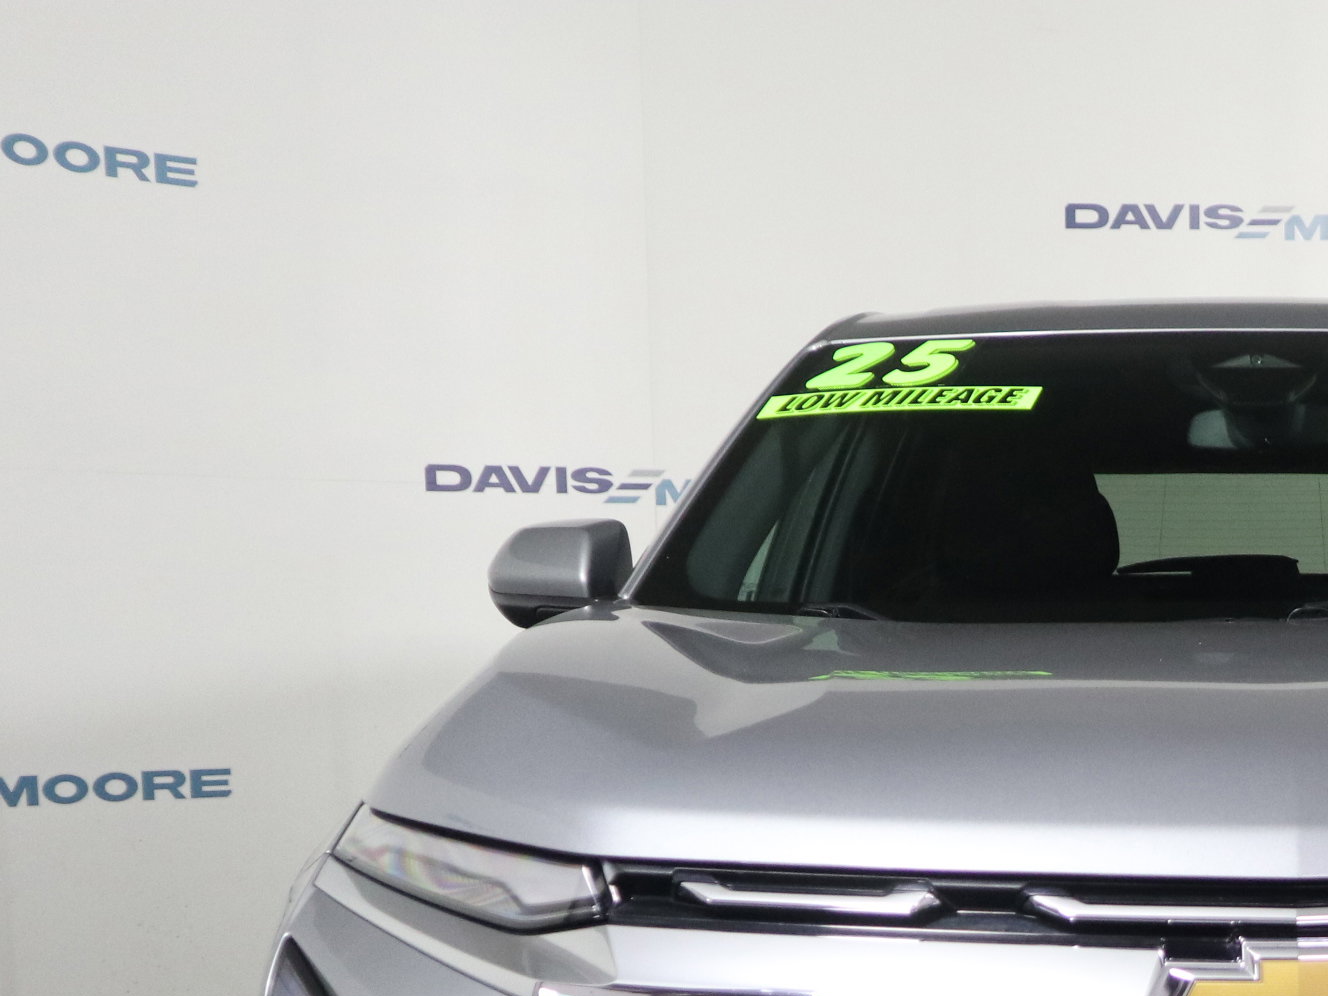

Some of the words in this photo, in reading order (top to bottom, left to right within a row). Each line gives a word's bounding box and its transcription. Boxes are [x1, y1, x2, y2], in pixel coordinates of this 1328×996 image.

[0, 132, 198, 188] OORE
[1064, 202, 1245, 230] DAVIS
[805, 339, 976, 390] 25
[776, 391, 862, 413] LOW
[860, 387, 1027, 408] MILEAGE
[424, 463, 614, 494] DAVIS
[0, 768, 232, 808] MOORE
